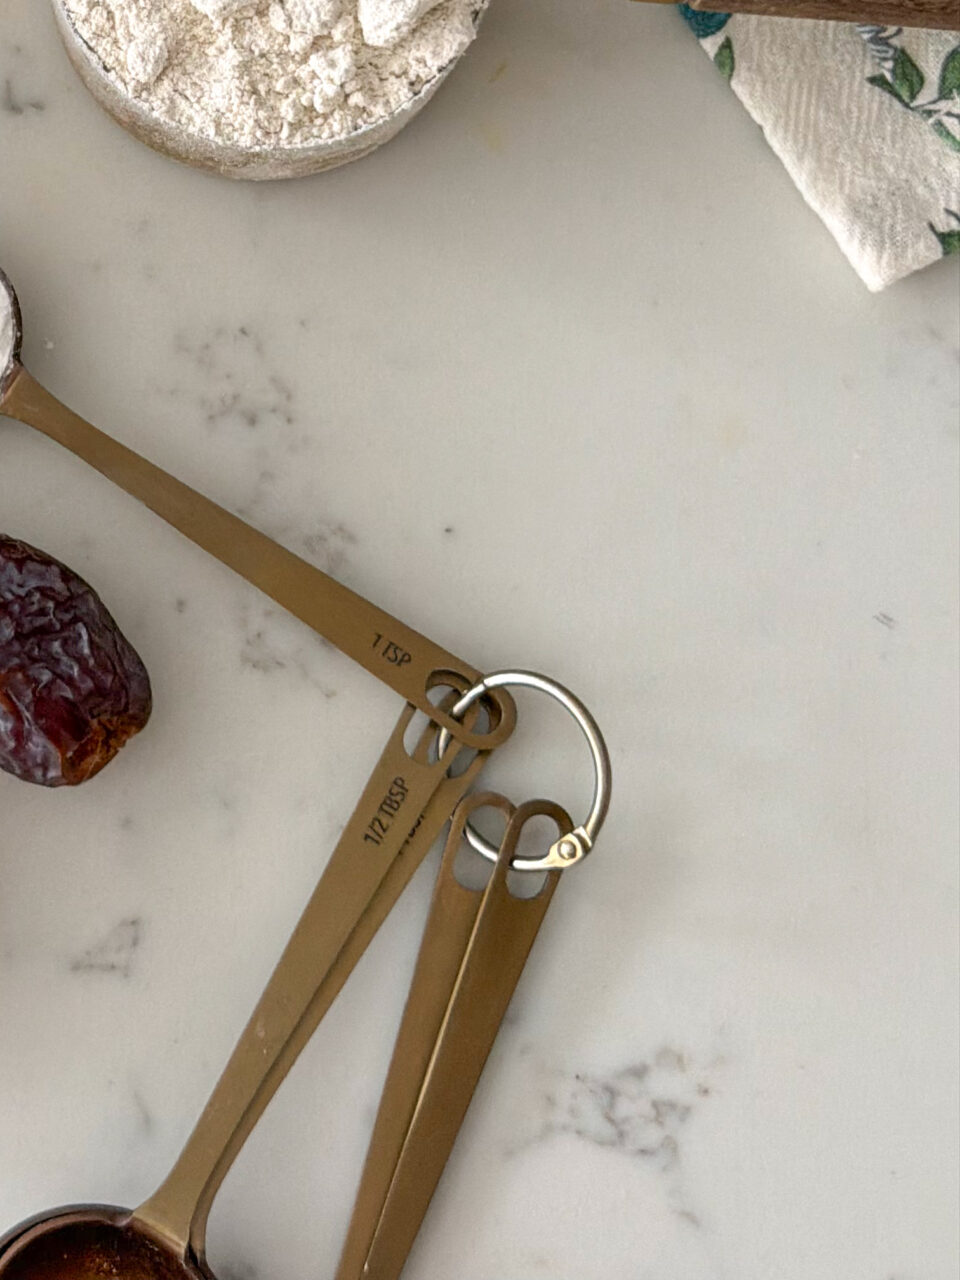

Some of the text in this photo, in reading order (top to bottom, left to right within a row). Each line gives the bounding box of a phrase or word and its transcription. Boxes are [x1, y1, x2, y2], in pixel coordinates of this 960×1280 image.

[371, 632, 412, 668] 1 TSP
[363, 775, 410, 847] 1/2 TBSP
